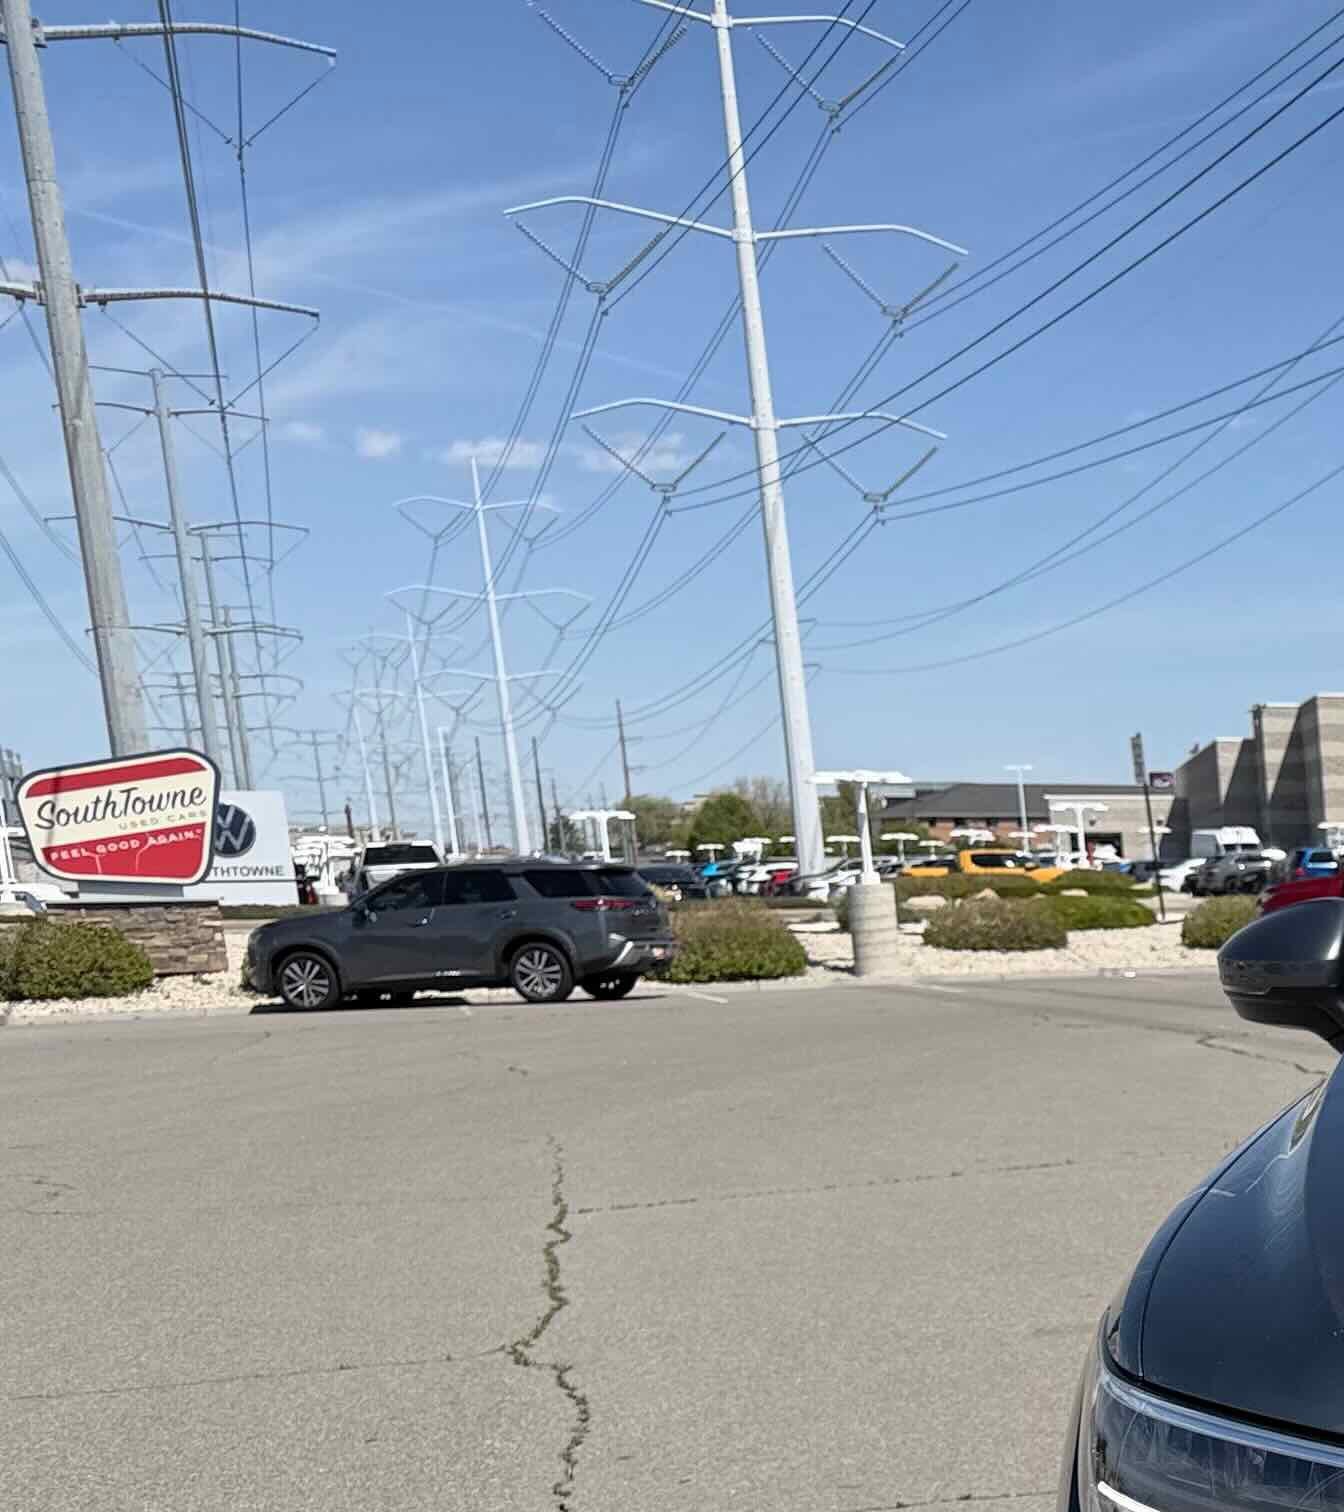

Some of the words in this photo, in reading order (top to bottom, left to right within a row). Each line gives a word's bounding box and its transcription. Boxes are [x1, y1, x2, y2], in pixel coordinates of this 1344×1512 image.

[34, 785, 206, 830] SouthTowne
[119, 817, 159, 831] USED
[167, 809, 208, 823] CARS
[51, 848, 88, 861] FEEL
[95, 838, 140, 853] GOOD
